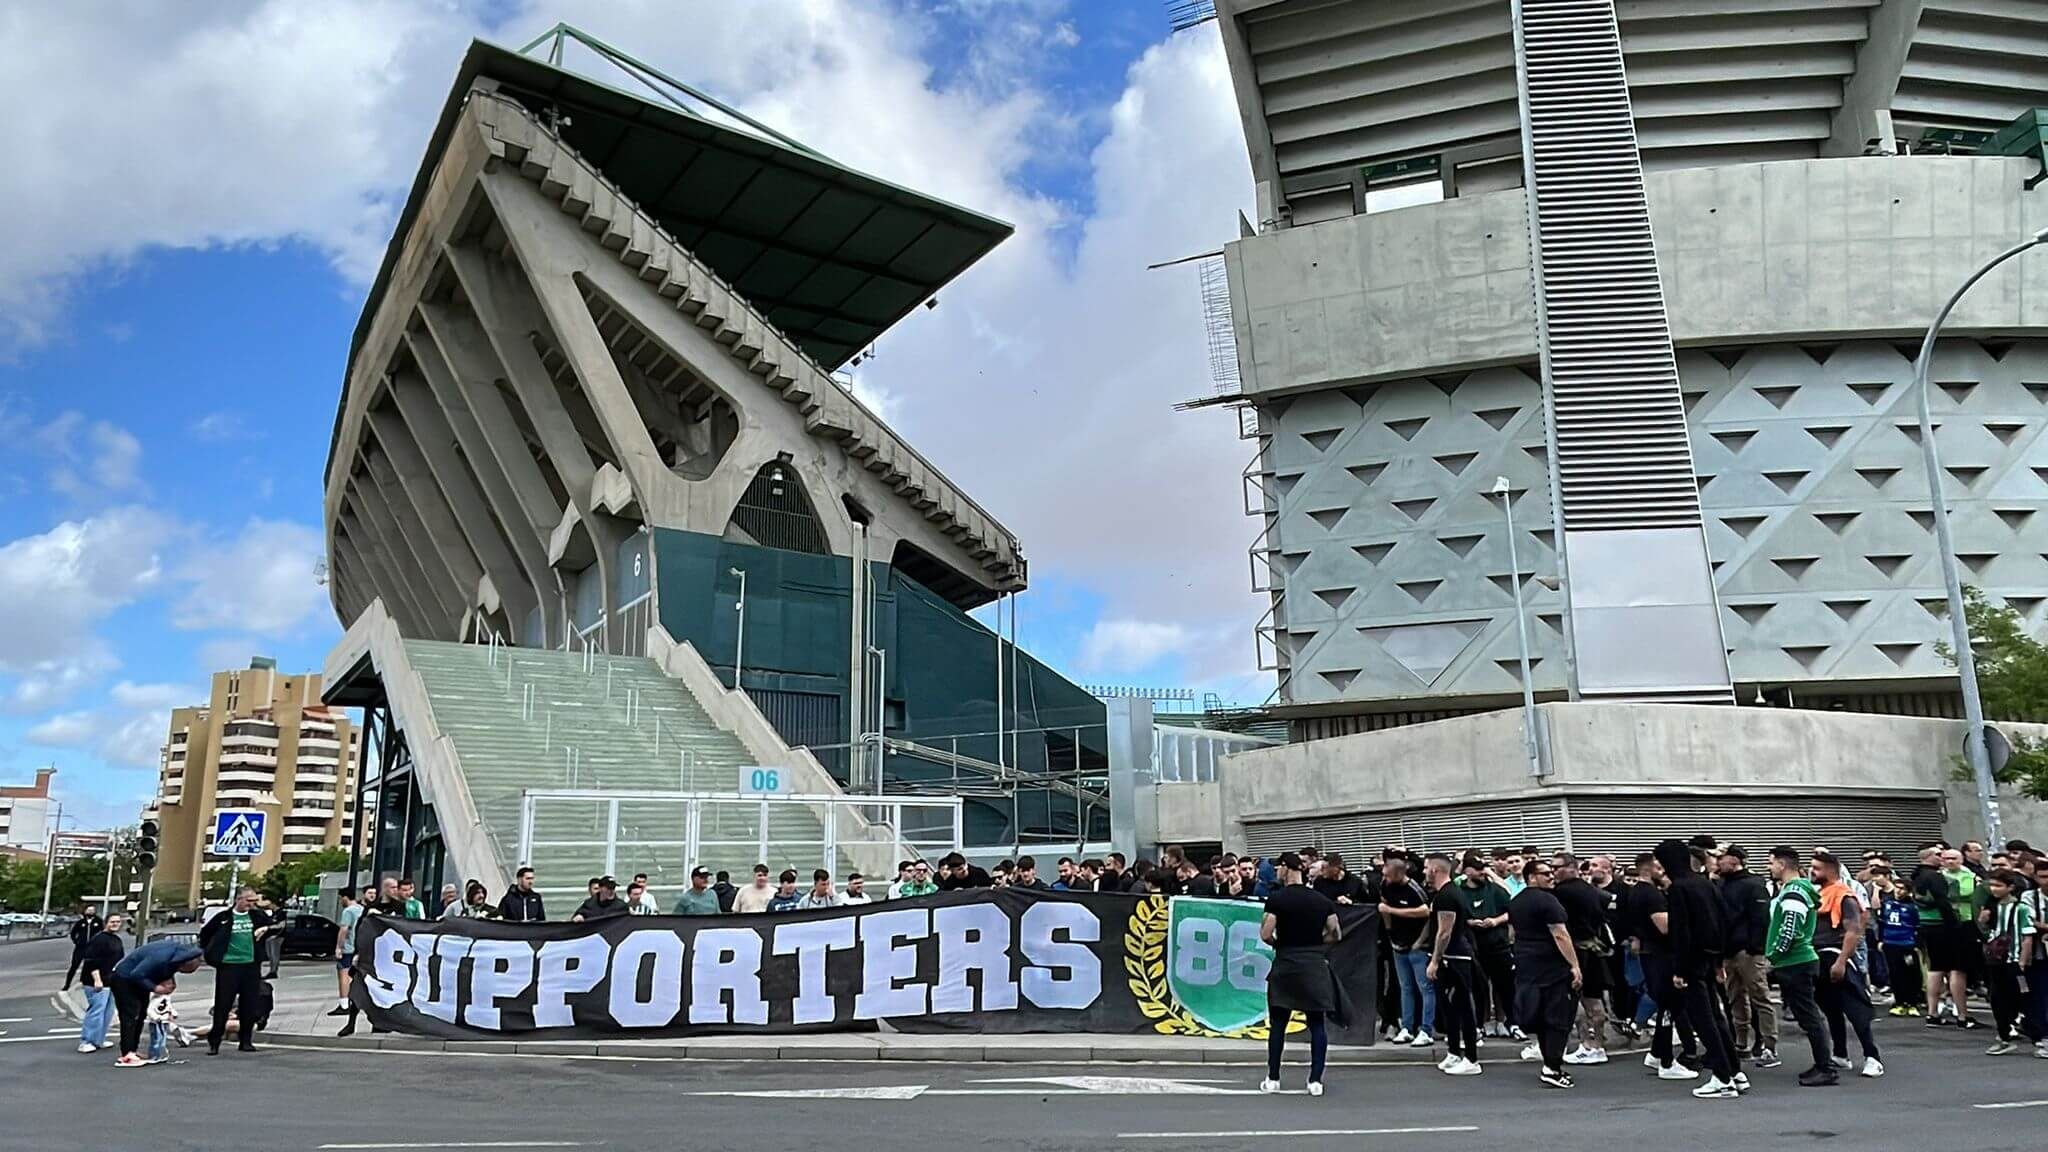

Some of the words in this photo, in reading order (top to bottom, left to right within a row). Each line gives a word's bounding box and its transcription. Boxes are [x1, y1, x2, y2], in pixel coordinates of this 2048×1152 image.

[634, 552, 641, 577] 6
[751, 769, 778, 791] 06
[364, 902, 1101, 1030] SUPPORTERS
[1175, 917, 1276, 991] 86
